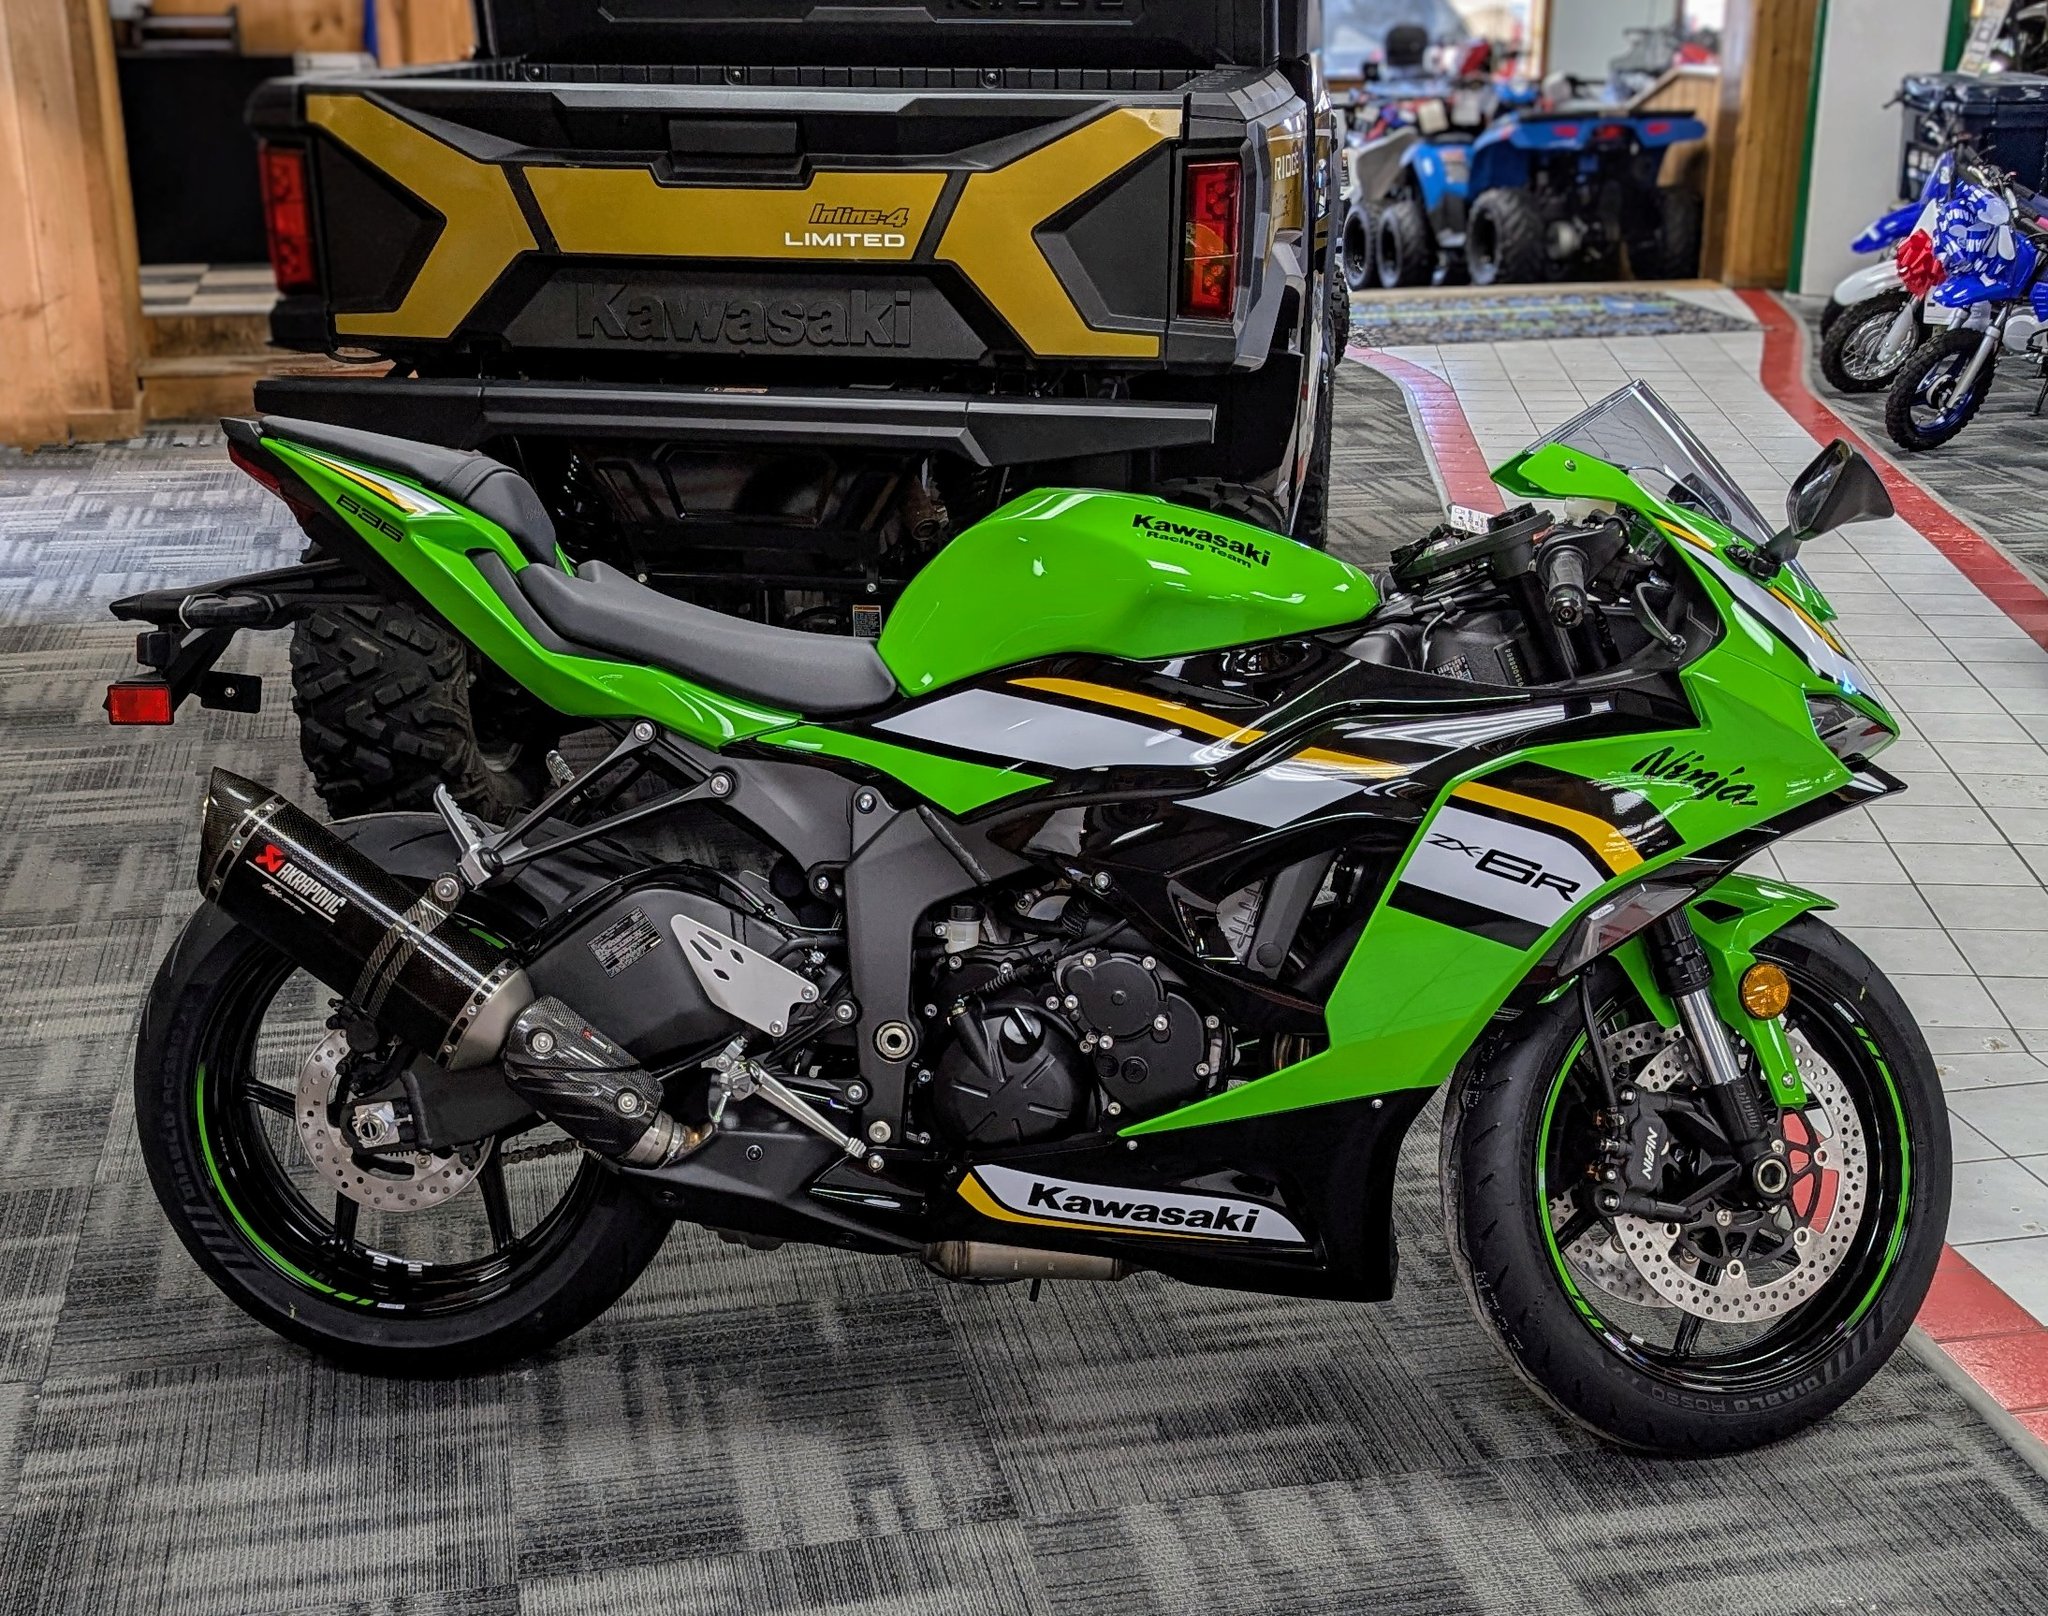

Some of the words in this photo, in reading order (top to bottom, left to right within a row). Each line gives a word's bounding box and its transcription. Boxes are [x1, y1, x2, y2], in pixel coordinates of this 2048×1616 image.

[784, 232, 906, 248] LIMITED
[808, 203, 910, 228] Inline-4
[576, 283, 912, 347] Kawasaki
[335, 494, 404, 543] 636
[1132, 514, 1271, 567] Kawasaki
[1146, 530, 1205, 551] Racing
[1208, 545, 1252, 569] Team
[1630, 746, 1759, 806] Ninja
[1027, 1182, 1260, 1233] Kawasaki
